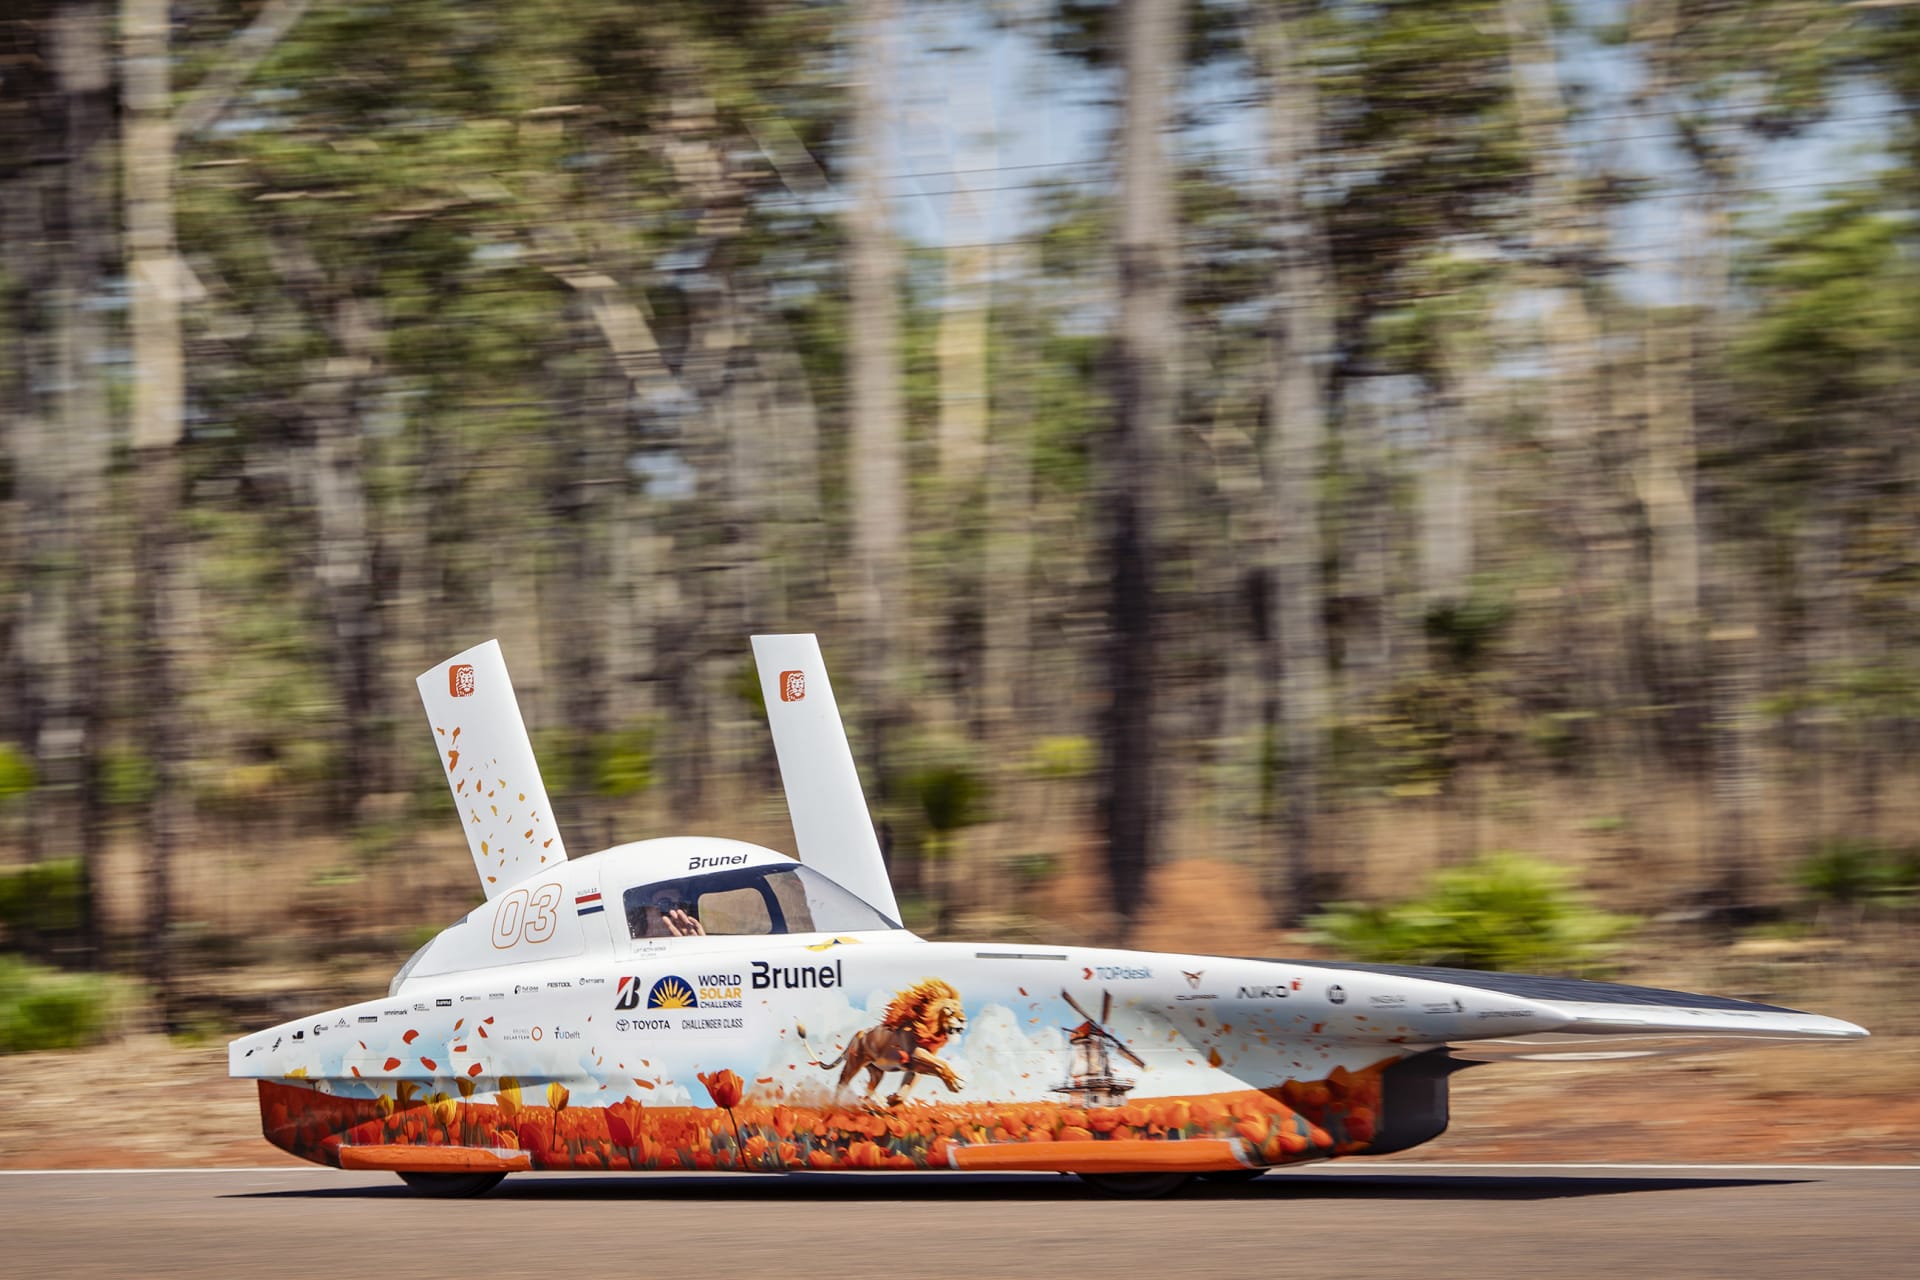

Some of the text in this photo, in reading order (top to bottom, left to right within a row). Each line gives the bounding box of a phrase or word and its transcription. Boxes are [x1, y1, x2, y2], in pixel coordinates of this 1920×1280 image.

[688, 854, 748, 870] Brunel
[490, 882, 562, 949] 03
[751, 959, 843, 990] Brunel
[1096, 966, 1153, 980] TOPdesk
[698, 974, 742, 986] WORLD
[699, 987, 742, 999] SOLAR
[700, 1000, 743, 1008] CHALLENGE
[632, 1020, 671, 1030] TOYOTA
[682, 1018, 743, 1029] CHALLENGER CLASS
